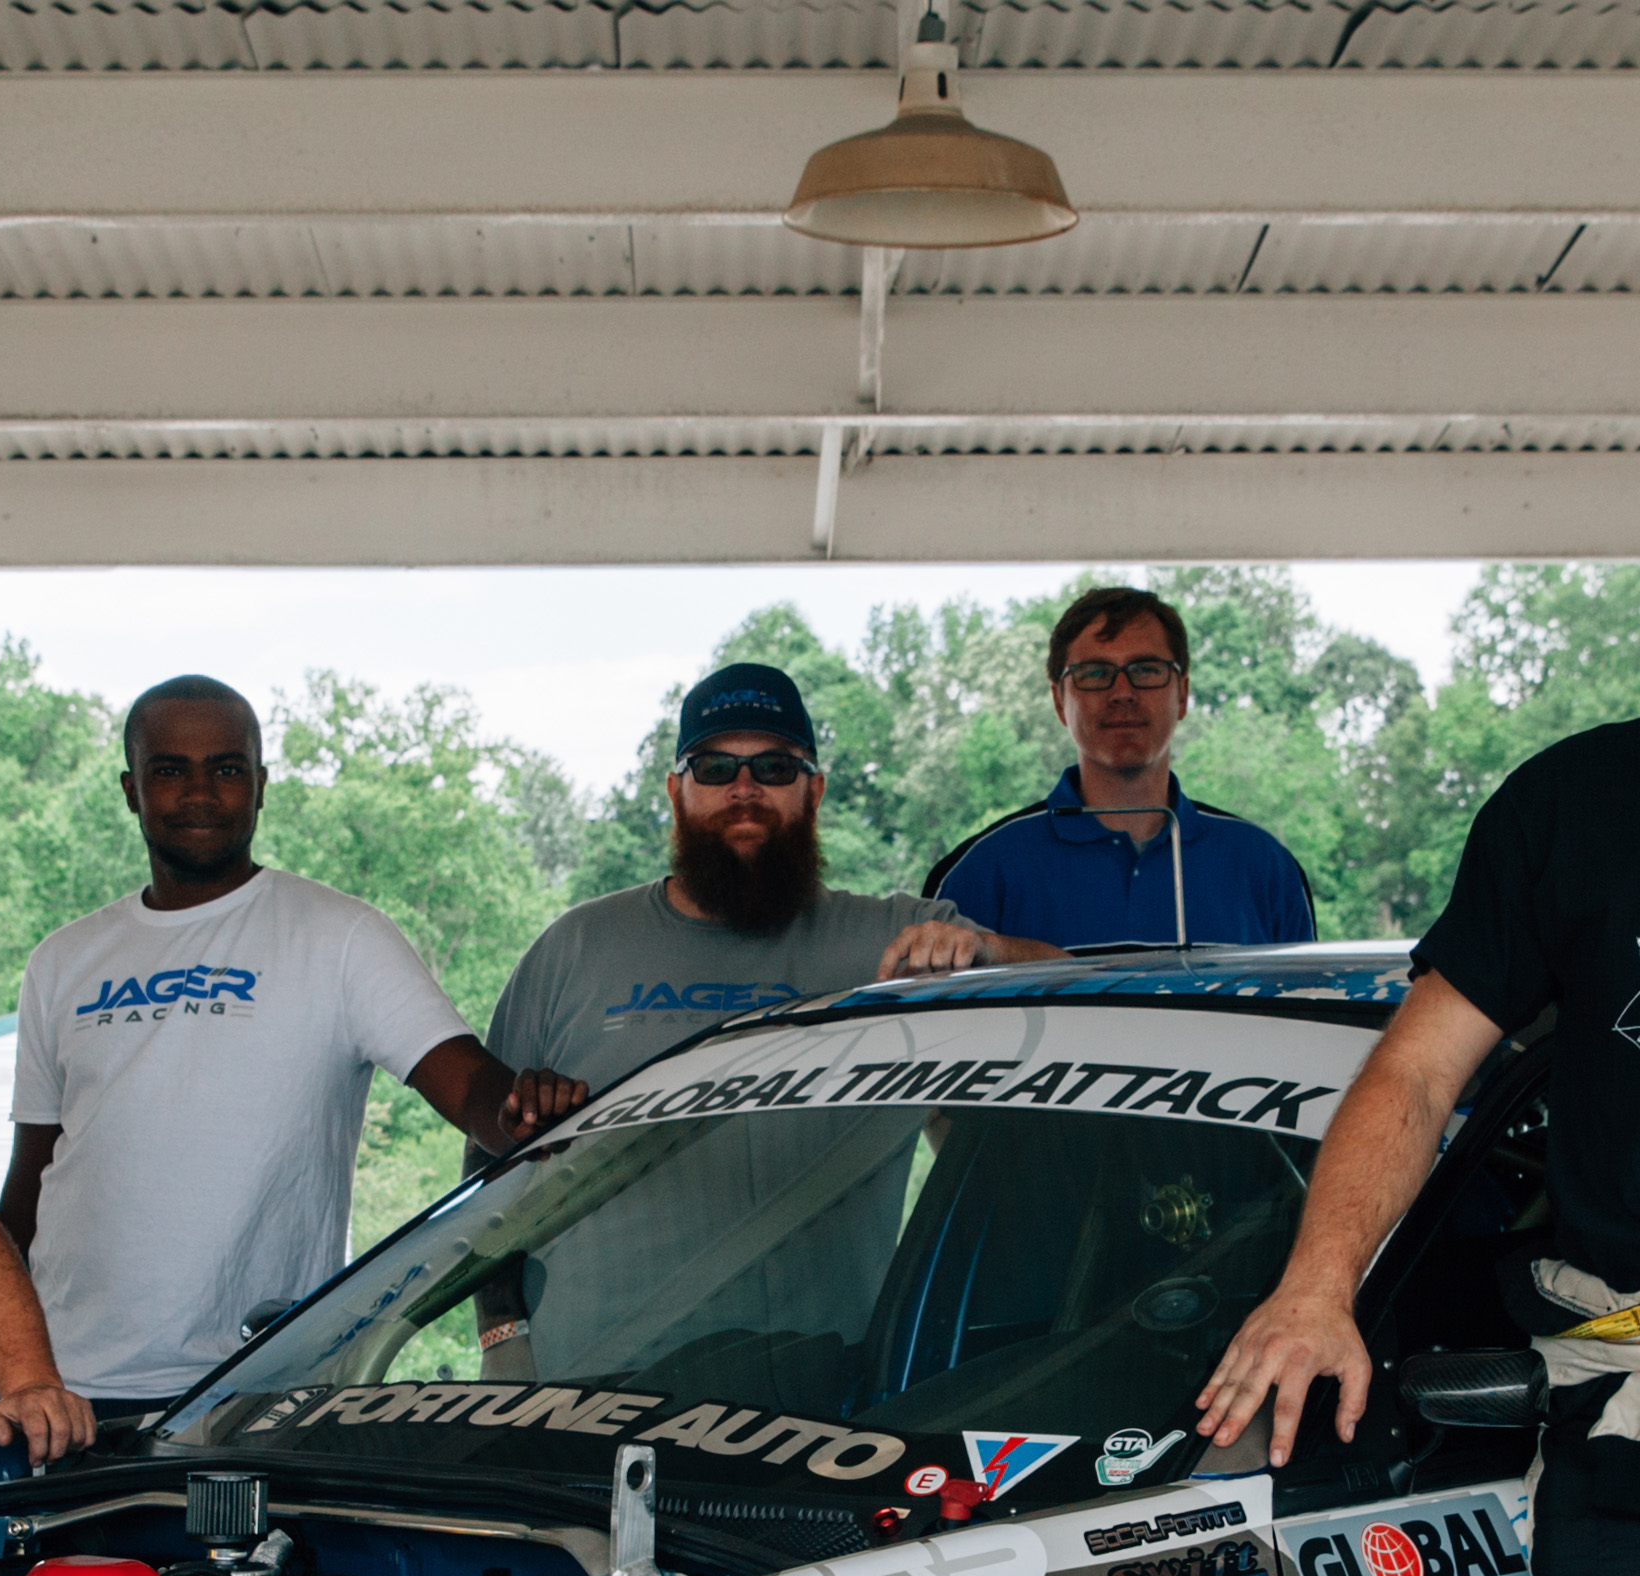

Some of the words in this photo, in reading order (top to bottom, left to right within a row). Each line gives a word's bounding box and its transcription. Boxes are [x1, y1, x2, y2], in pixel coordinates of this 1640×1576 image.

[76, 964, 256, 1016] JAGER
[97, 1001, 227, 1026] RACNG
[576, 1068, 822, 1133] GLOBAL
[826, 1060, 1021, 1103] TIME
[1000, 1061, 1341, 1131] ATTACK
[297, 1383, 664, 1436] FORTUNE
[632, 1403, 907, 1480] AUTO
[1106, 1437, 1149, 1451] GTA
[916, 1473, 938, 1489] E
